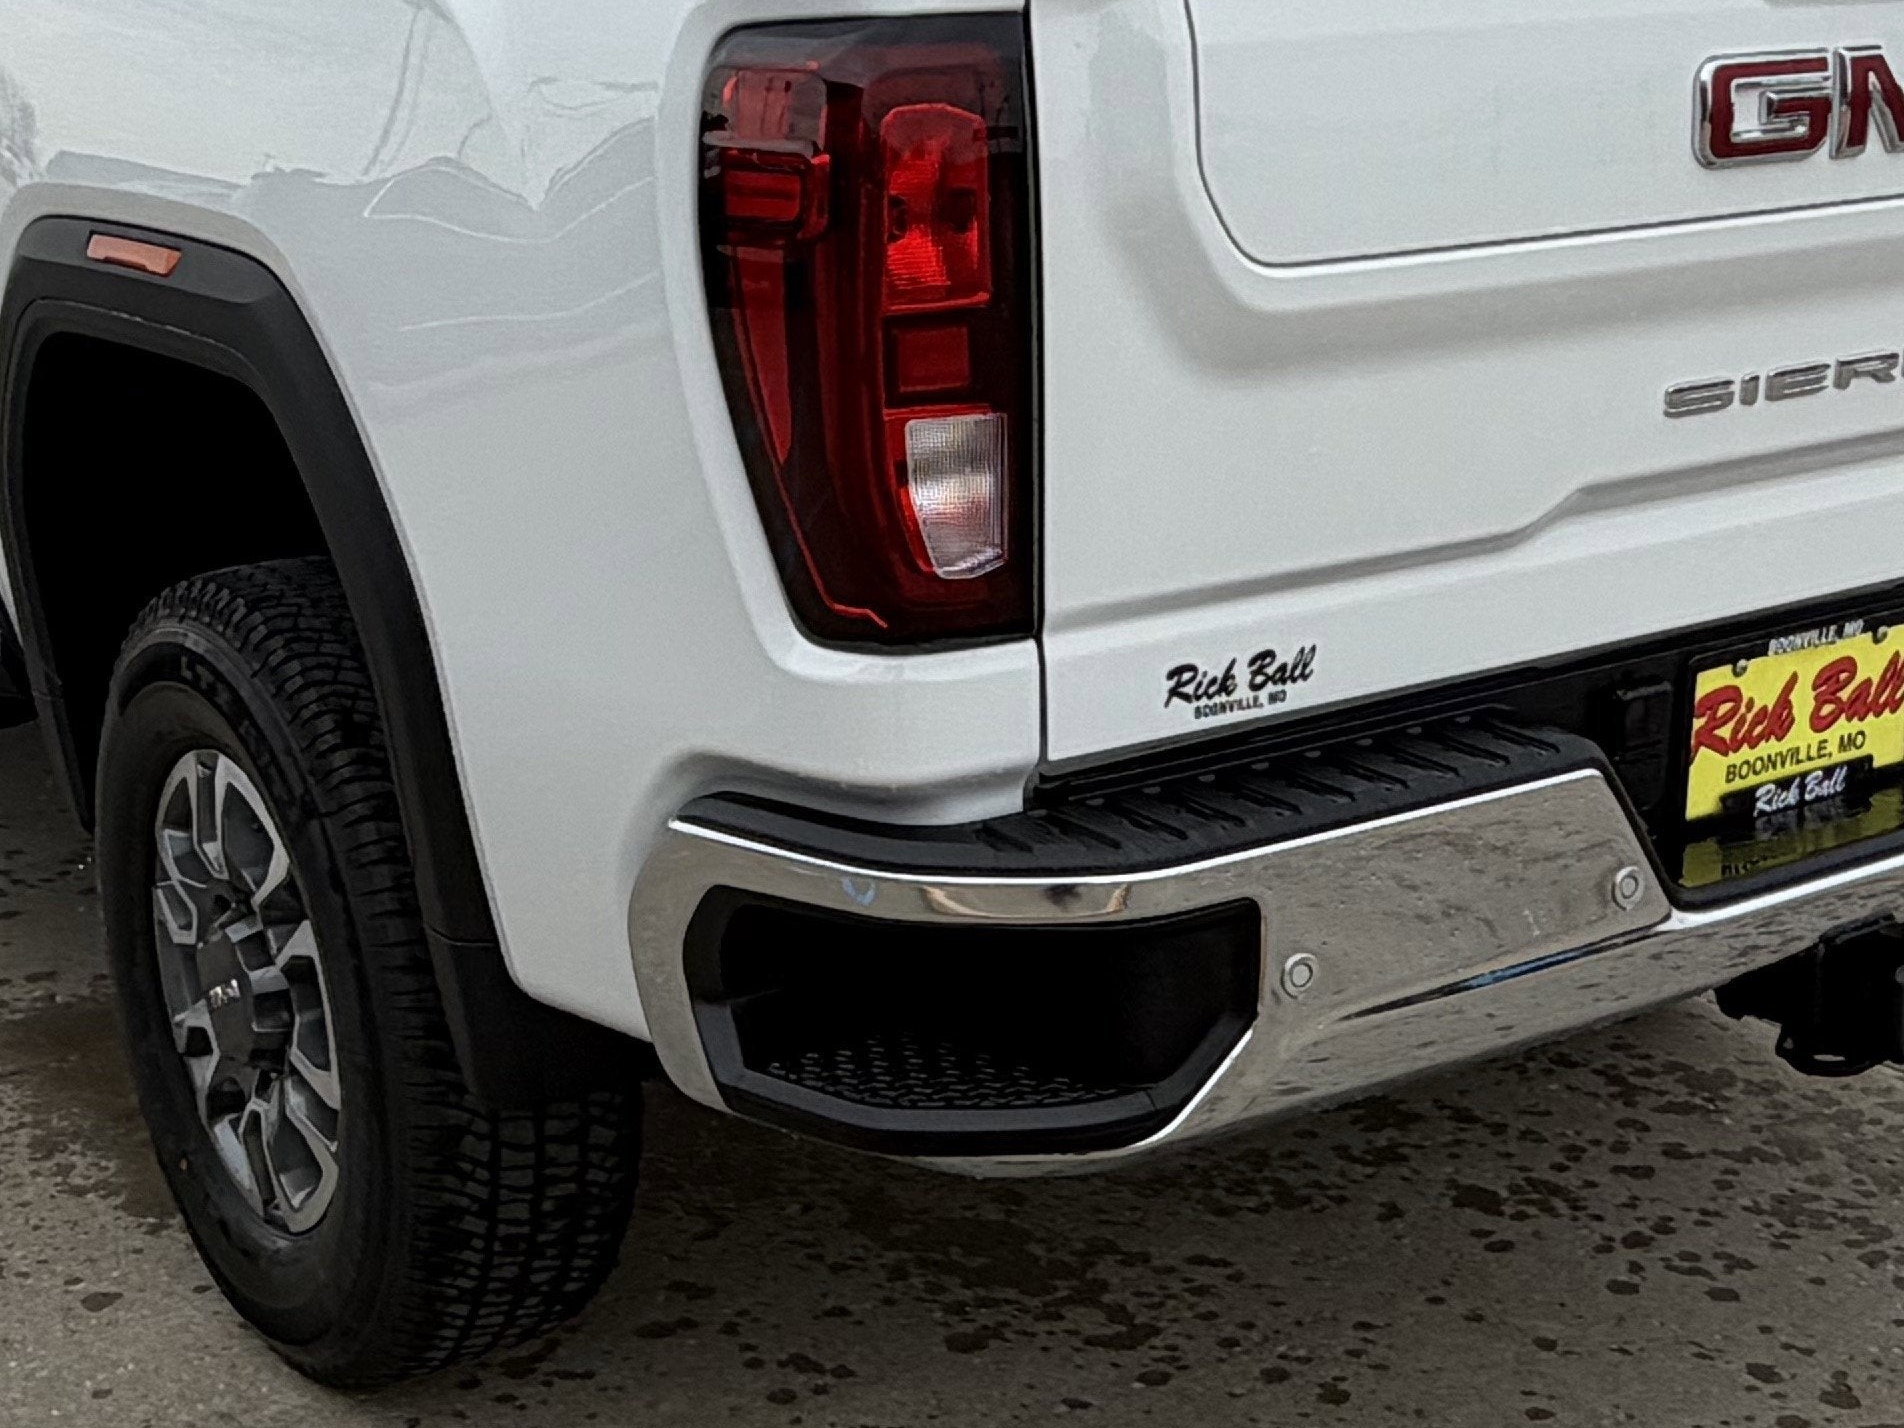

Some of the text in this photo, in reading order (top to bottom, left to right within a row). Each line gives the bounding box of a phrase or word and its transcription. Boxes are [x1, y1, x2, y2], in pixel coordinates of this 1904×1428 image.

[1164, 644, 1316, 708] Rick Ball
[1690, 670, 1799, 762] Rick
[1725, 730, 1866, 784] BOONVILLE, MO
[1753, 766, 1848, 818] Rick Ball
